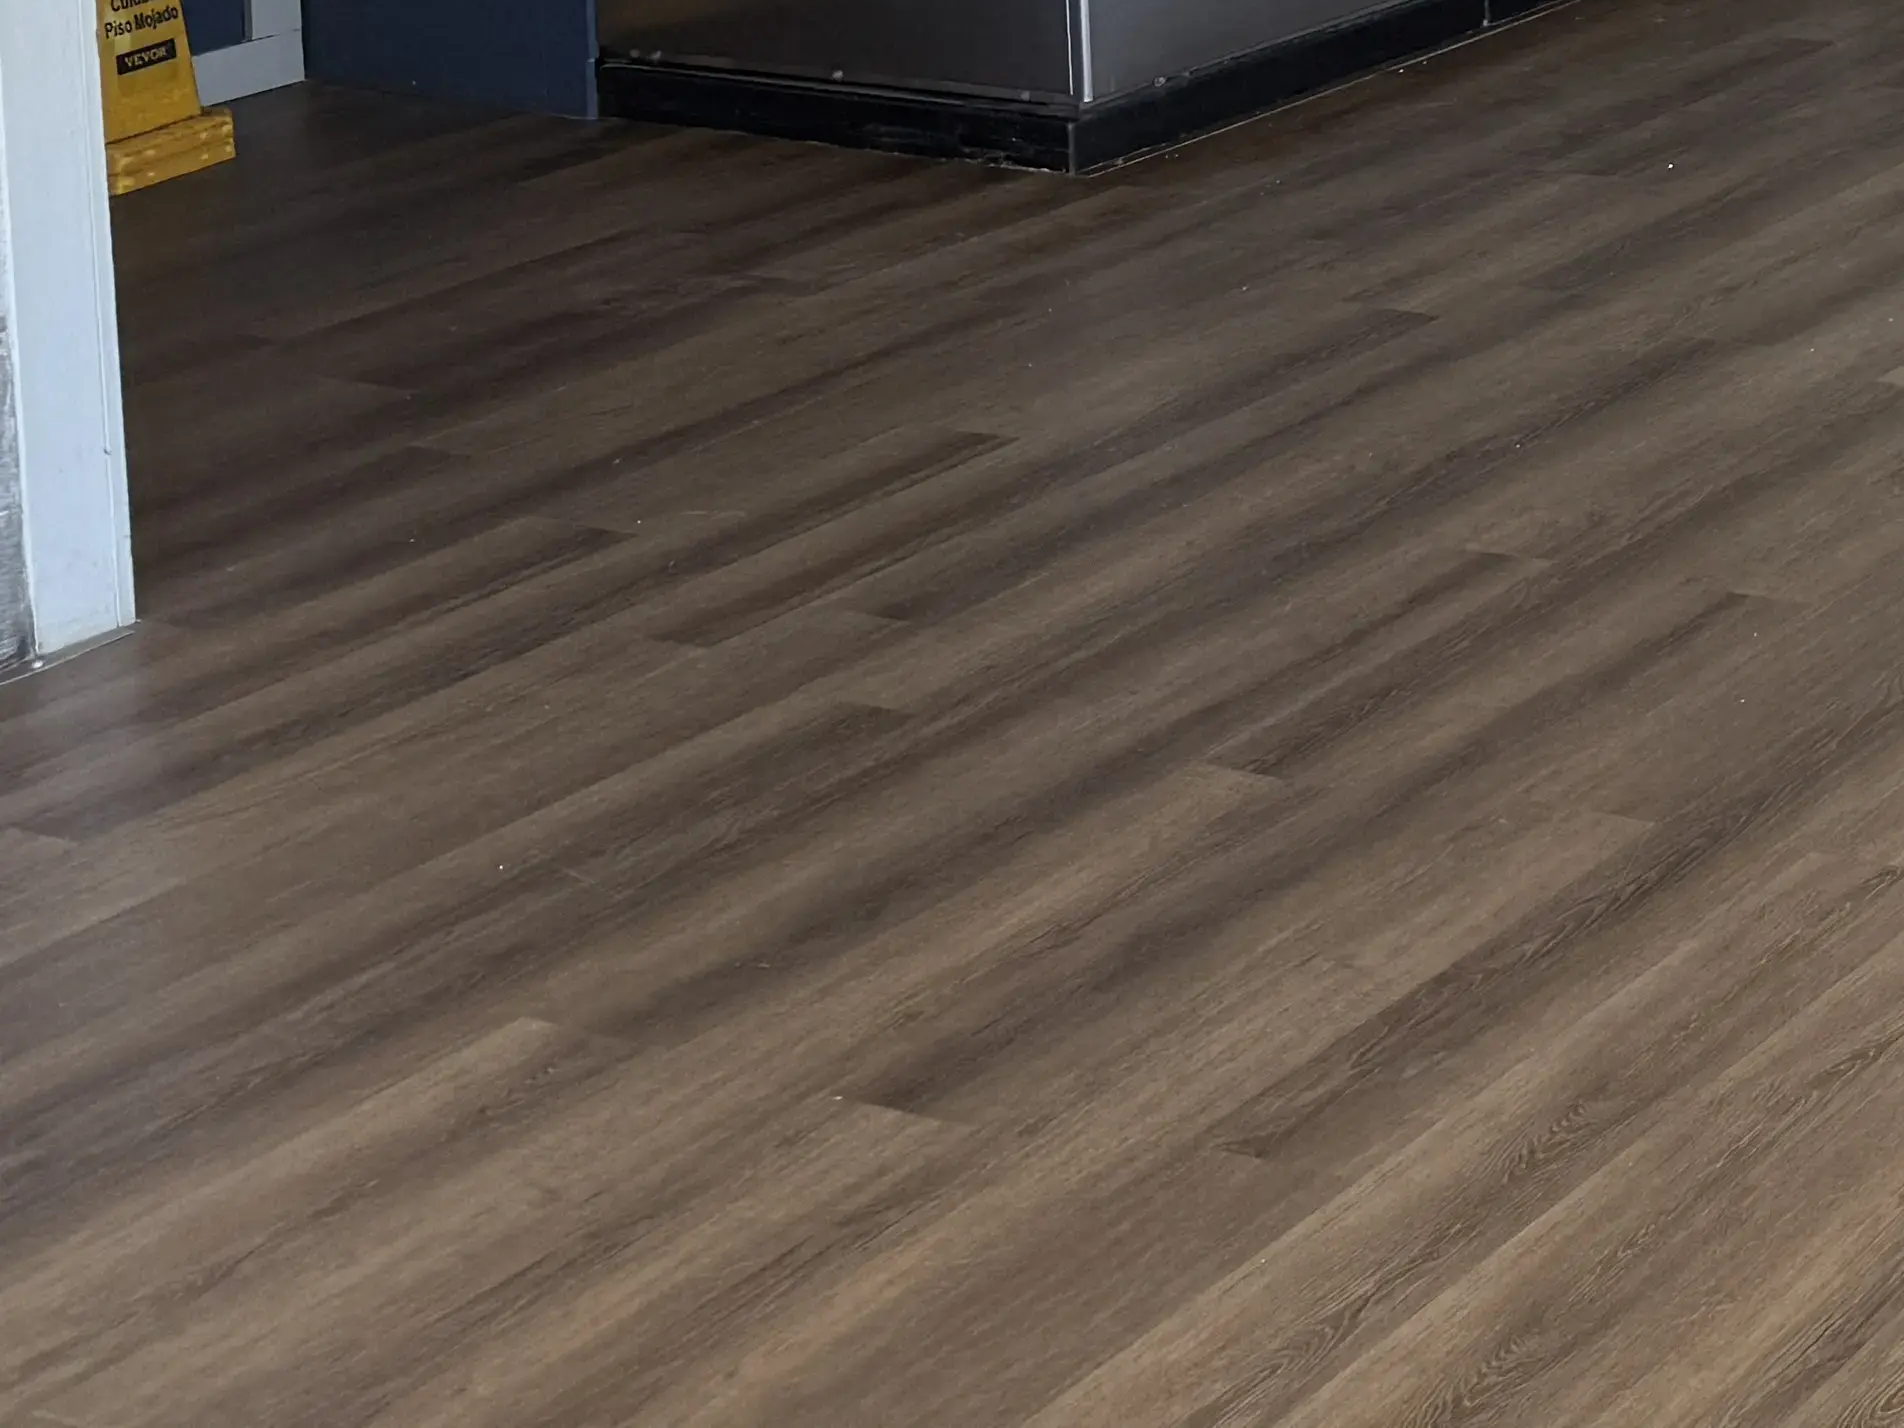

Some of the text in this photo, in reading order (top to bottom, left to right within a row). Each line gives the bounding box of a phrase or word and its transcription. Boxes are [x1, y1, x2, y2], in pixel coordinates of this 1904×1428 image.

[104, 4, 179, 40] Piso Mojado
[124, 46, 167, 67] VEVOR
